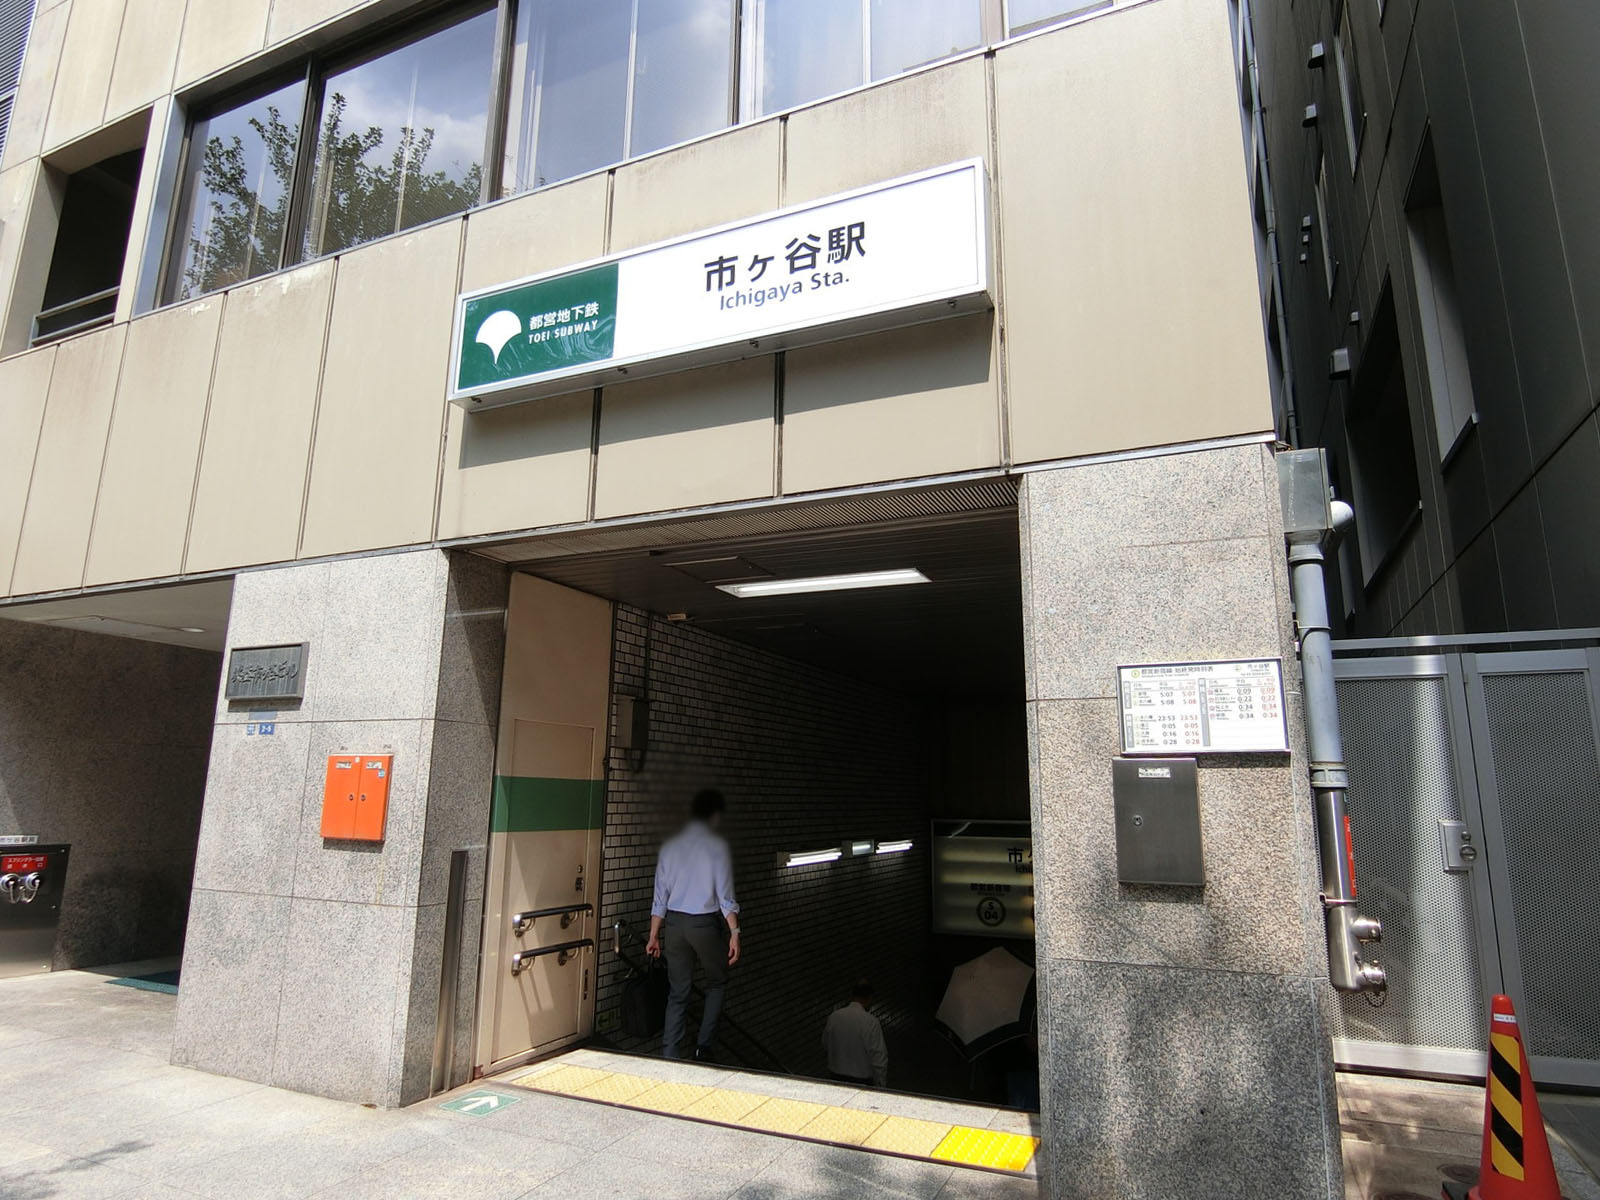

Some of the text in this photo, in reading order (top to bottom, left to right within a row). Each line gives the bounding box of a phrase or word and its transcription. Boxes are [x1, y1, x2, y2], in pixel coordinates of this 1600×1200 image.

[704, 221, 866, 292] 市ヶ谷駅
[720, 271, 849, 310] Ichigaya Sta.
[530, 302, 599, 330] 都営地下鉄
[528, 320, 598, 344] TOEI SUBWAY
[984, 911, 999, 921] 04
